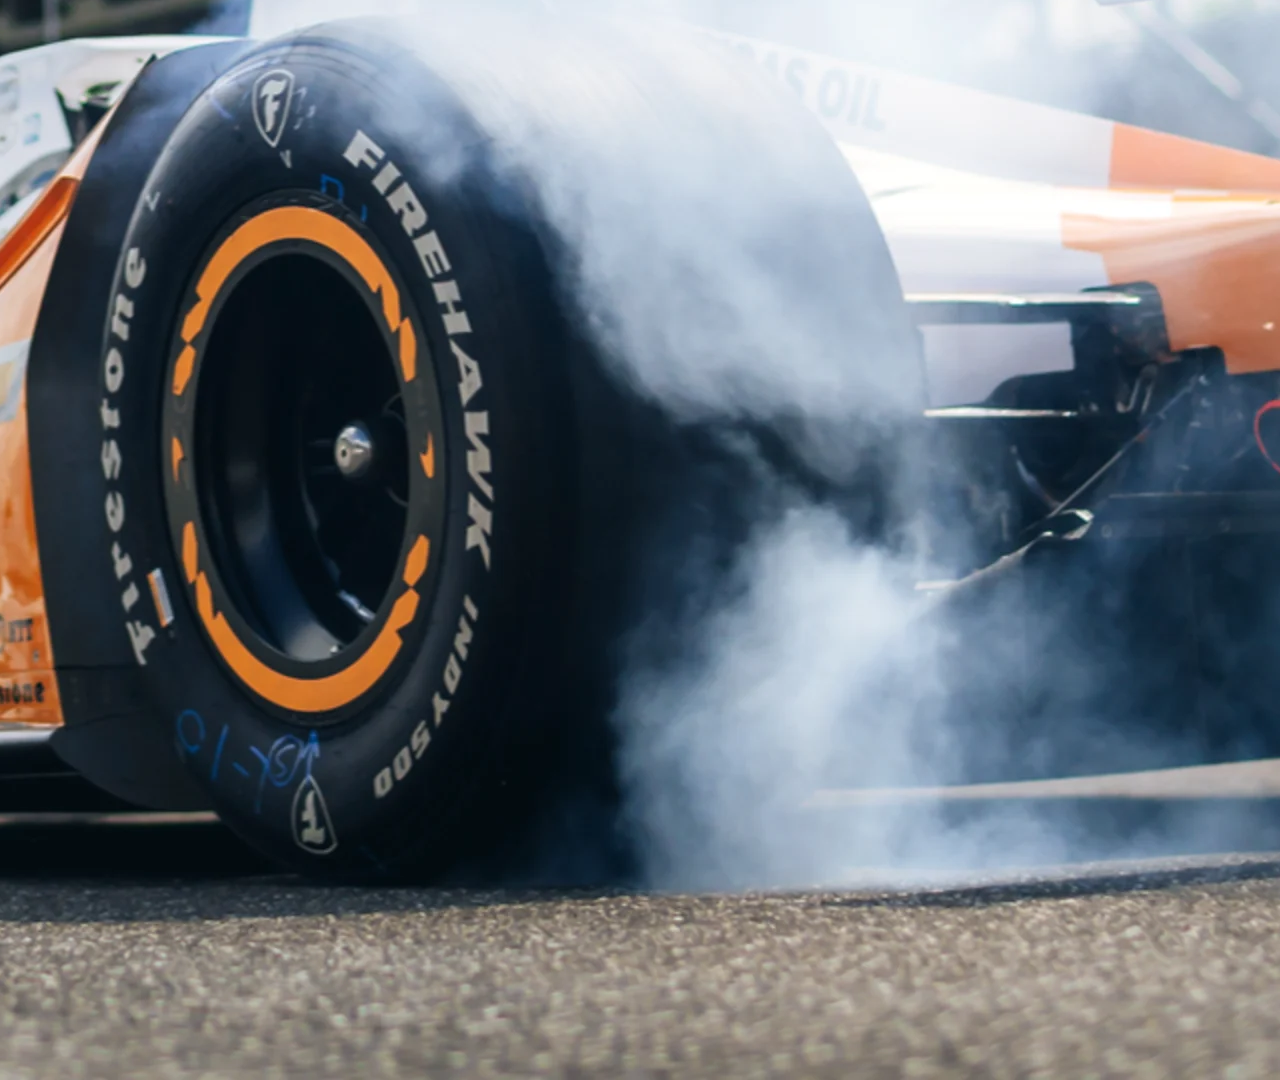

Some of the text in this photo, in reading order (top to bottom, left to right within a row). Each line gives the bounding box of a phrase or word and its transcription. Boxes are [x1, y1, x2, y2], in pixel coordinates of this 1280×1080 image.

[818, 66, 887, 133] OIL
[101, 247, 155, 665] Firestone
[342, 130, 494, 571] FIREHAWK
[373, 594, 479, 799] INDY 500
